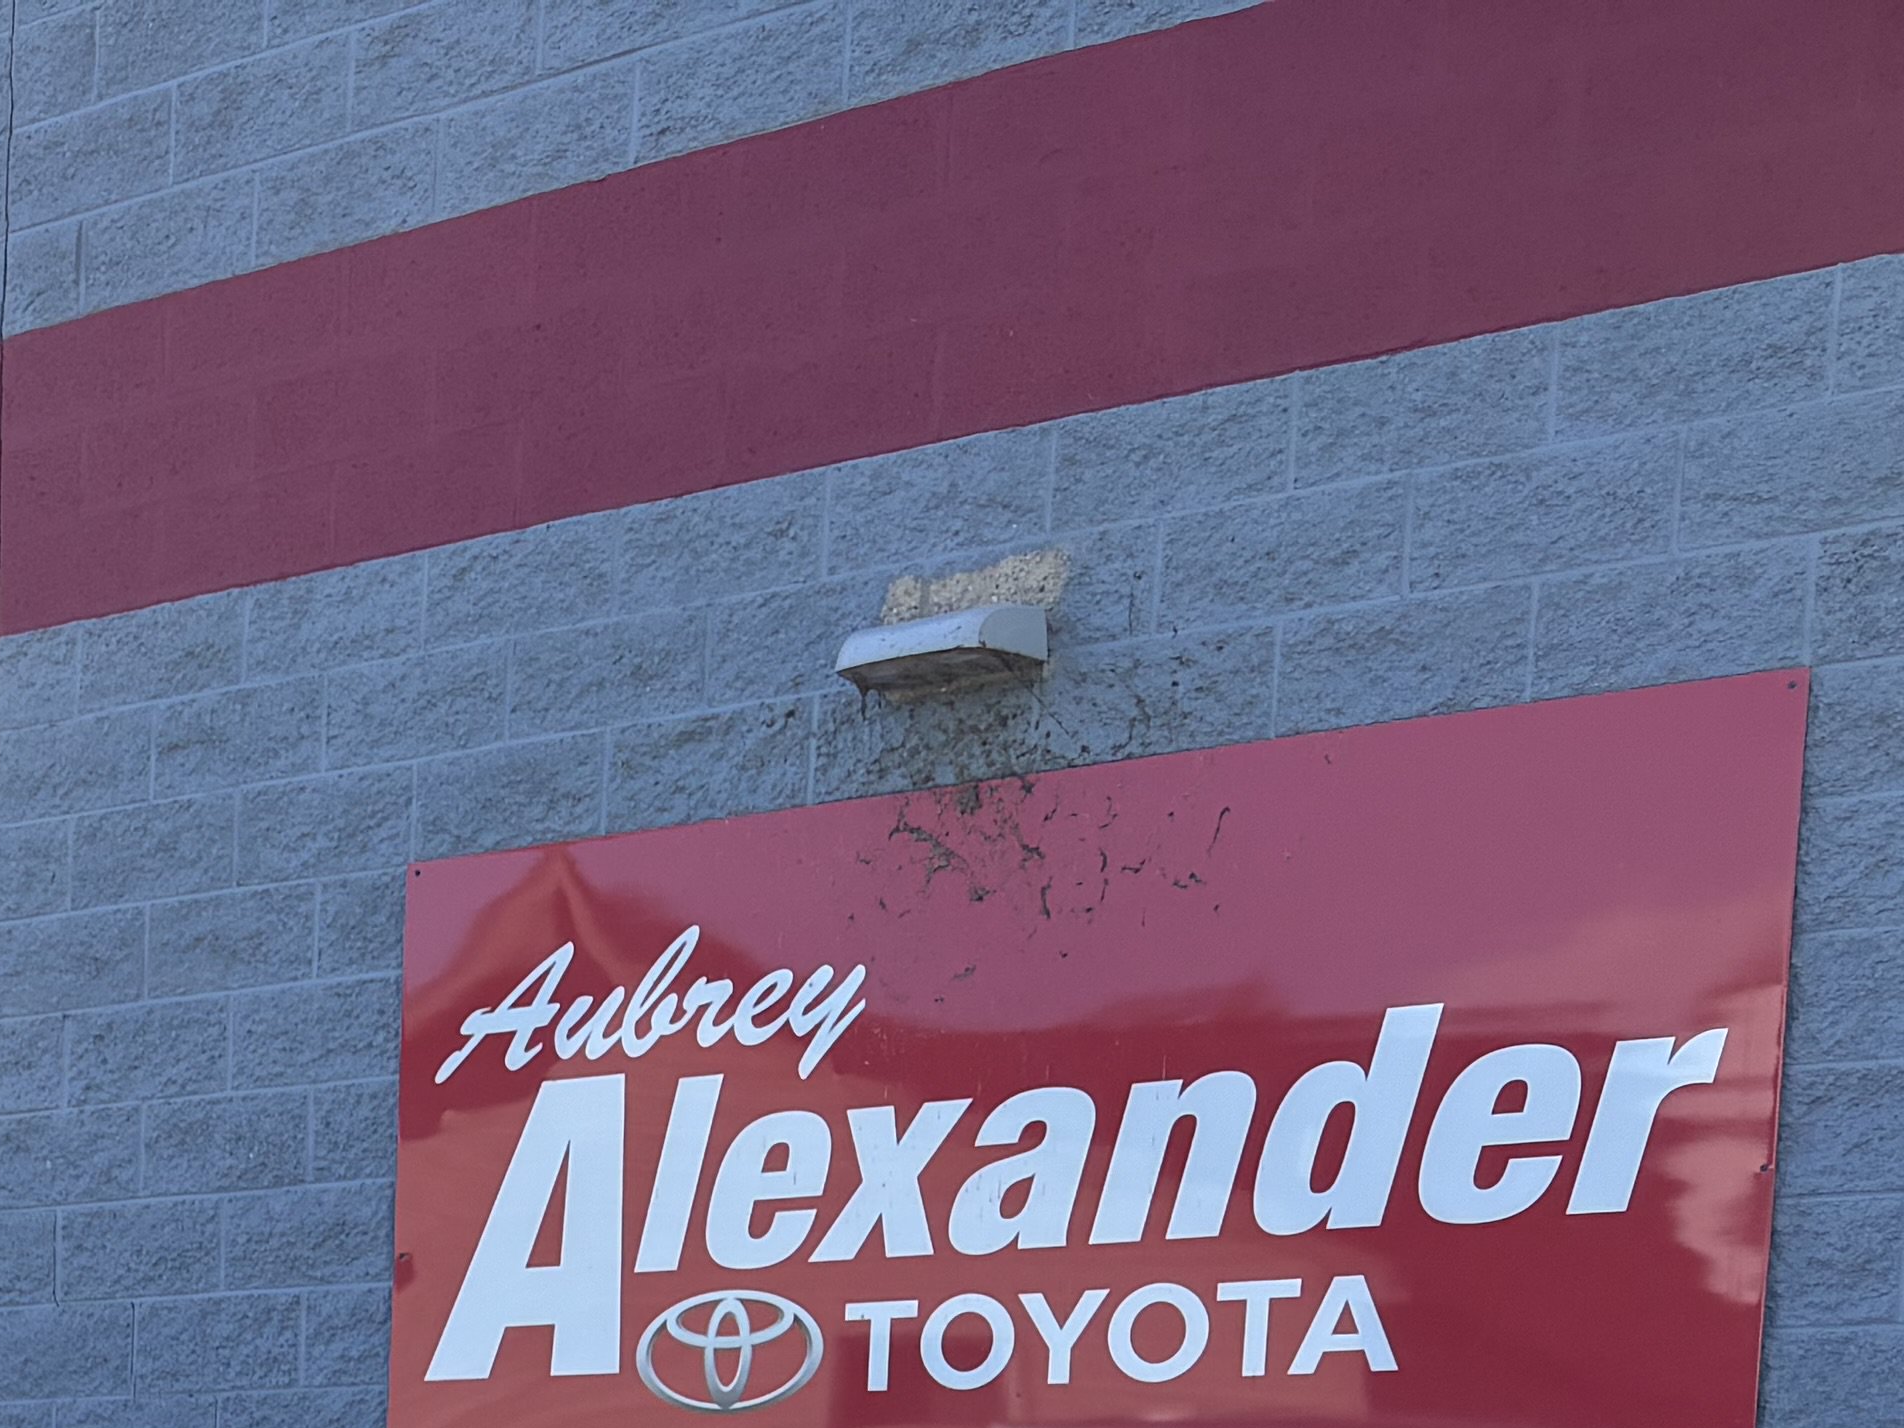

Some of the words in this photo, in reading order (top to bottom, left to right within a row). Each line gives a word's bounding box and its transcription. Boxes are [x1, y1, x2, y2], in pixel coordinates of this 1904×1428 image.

[435, 924, 866, 1083] Aubrey
[424, 1003, 1728, 1381] Alexander
[845, 1275, 1398, 1393] TOYOTA
